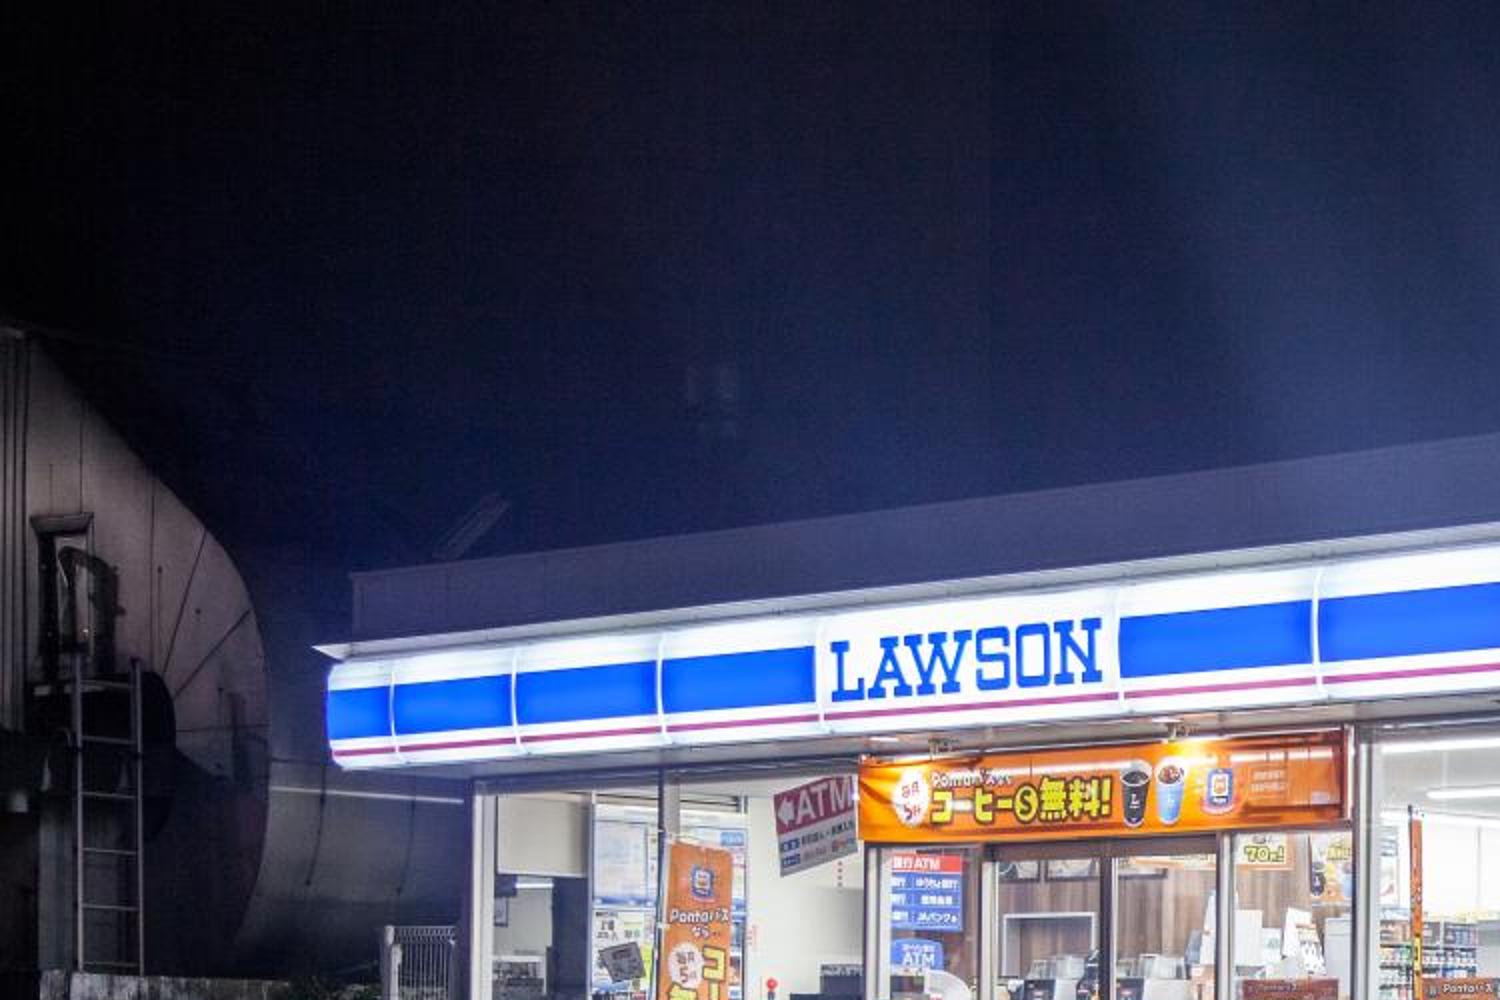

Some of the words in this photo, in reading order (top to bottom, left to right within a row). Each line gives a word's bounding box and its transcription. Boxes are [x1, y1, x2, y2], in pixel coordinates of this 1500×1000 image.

[830, 616, 1103, 703] LAWSON
[795, 778, 854, 825] ATM
[902, 952, 936, 968] ATM
